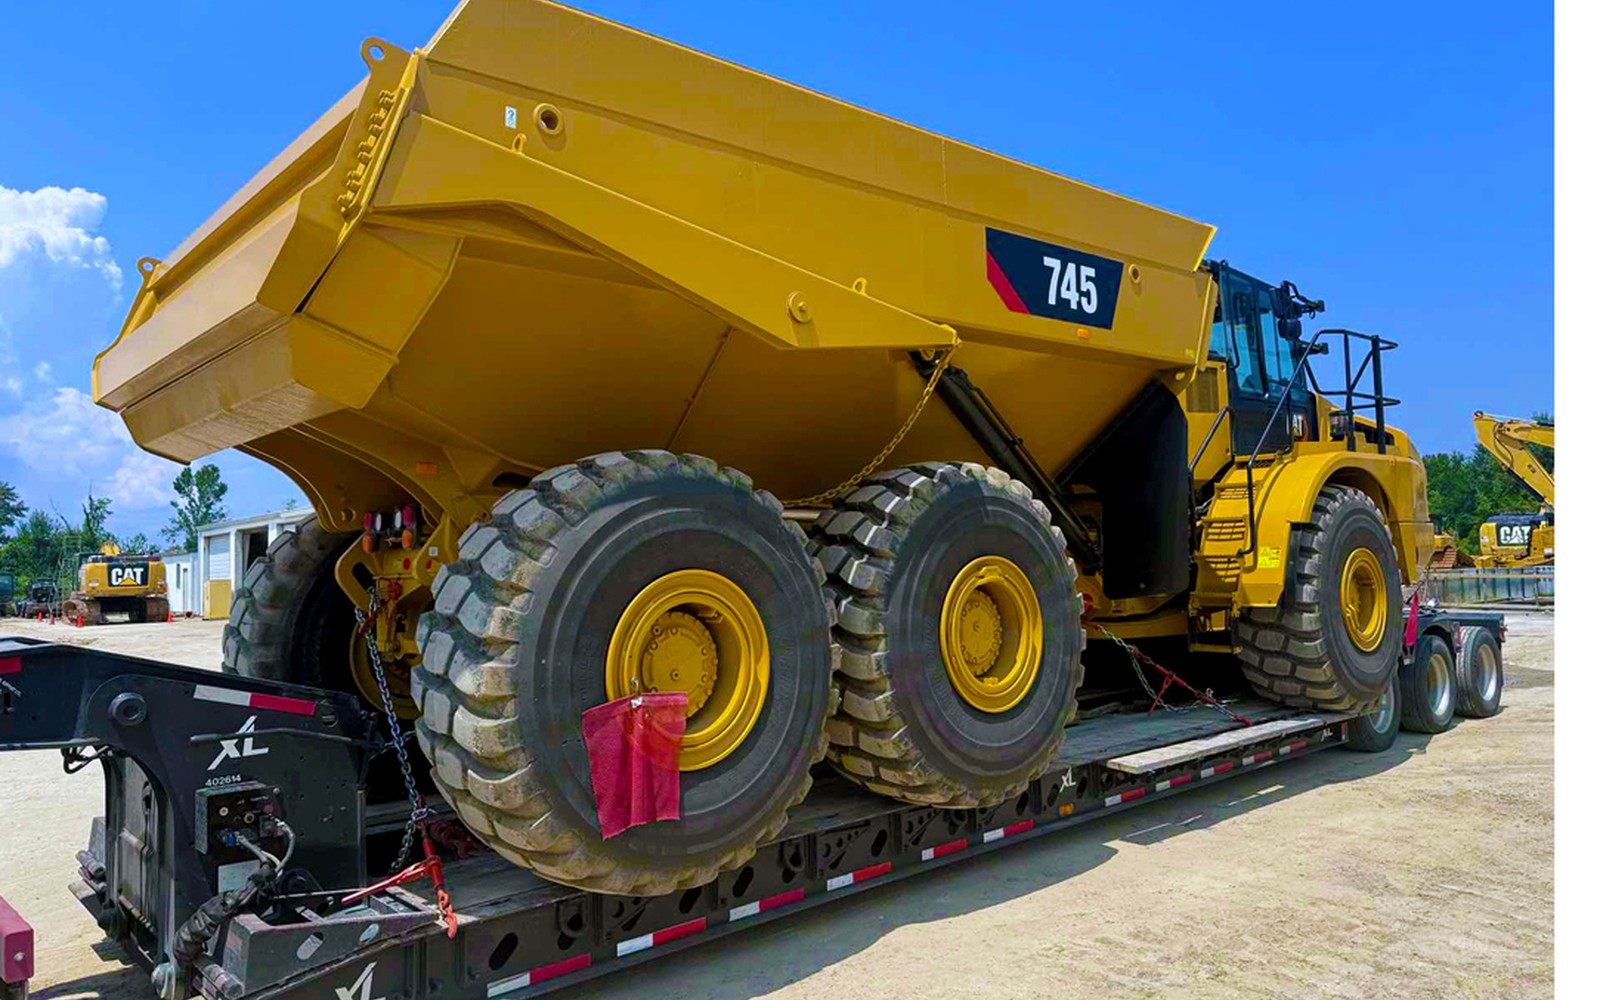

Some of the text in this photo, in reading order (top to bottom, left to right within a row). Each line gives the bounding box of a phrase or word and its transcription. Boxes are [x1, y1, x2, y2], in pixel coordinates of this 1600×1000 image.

[1043, 255, 1098, 314] 745
[1500, 525, 1531, 544] CAT
[111, 567, 144, 585] CAT
[207, 715, 269, 771] XL
[205, 774, 241, 787] 402614
[1060, 766, 1076, 792] XL
